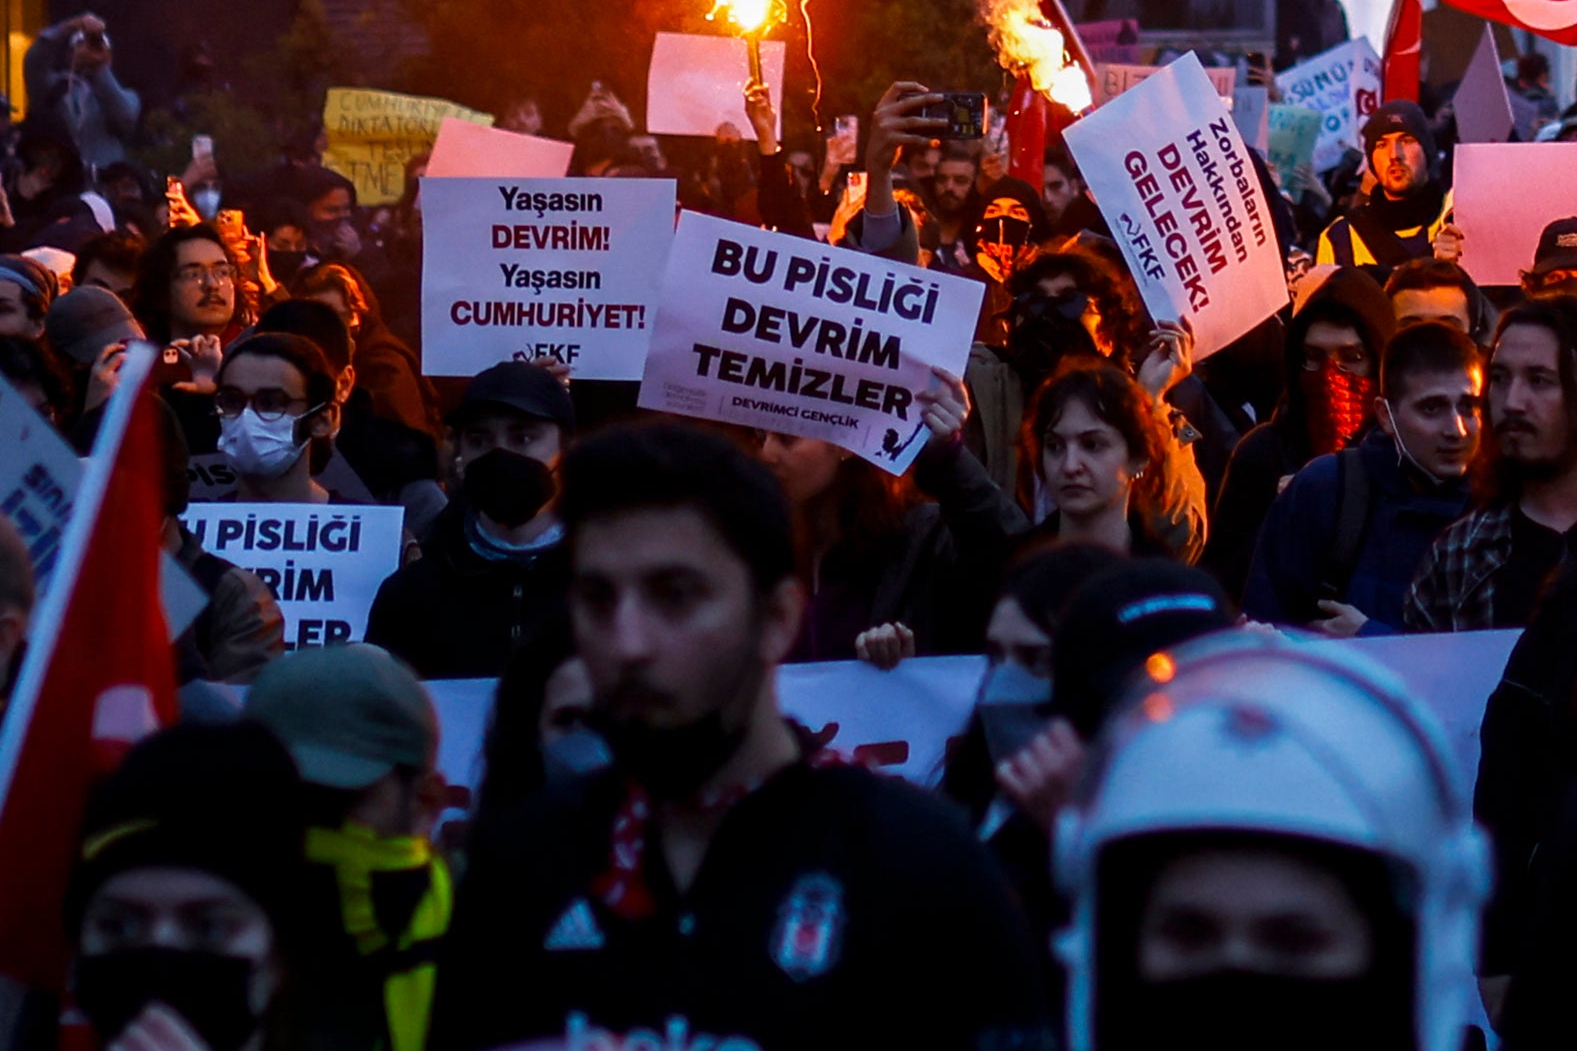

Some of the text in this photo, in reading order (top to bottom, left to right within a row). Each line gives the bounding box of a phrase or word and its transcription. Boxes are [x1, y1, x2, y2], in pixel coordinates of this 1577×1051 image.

[498, 186, 603, 218] Yaşasın
[1186, 129, 1249, 264] Hakkından
[1208, 116, 1267, 247] Zorbaların
[1123, 149, 1211, 314] GELECEK!
[1157, 142, 1228, 275] DEVRİM
[491, 220, 610, 251] DEVRİM!
[1131, 231, 1166, 281] FKF
[499, 263, 601, 295] Yaşasın
[711, 238, 939, 325] BU PİSLİĞİ
[450, 298, 646, 329] CUMHURİYET!
[721, 296, 902, 370] DEVRİM
[534, 343, 581, 364] FKF
[692, 342, 913, 422] TEMİZLER
[732, 395, 799, 418] DEVRİMCİ
[801, 408, 860, 430] GENÇLİK
[215, 513, 362, 553] PİSLİĞİ
[250, 559, 335, 603] RİM
